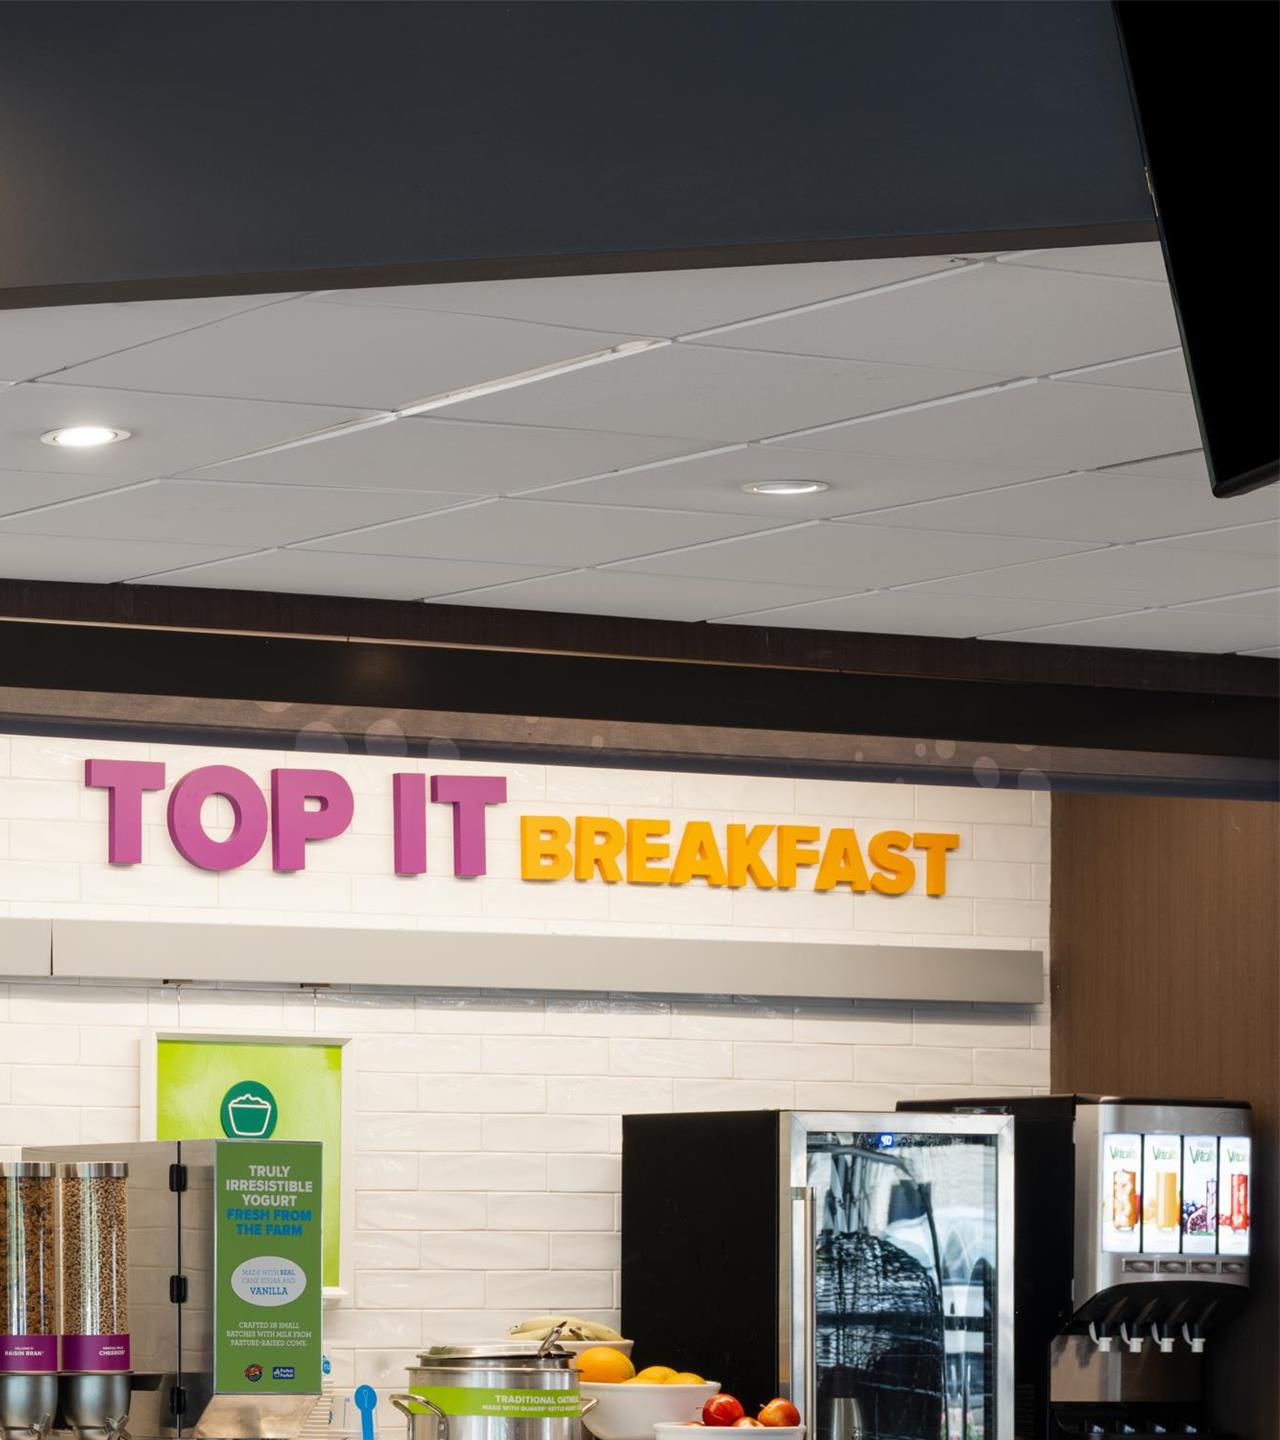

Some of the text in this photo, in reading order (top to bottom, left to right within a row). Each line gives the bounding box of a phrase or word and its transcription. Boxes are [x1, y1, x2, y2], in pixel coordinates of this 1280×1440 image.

[84, 758, 961, 897] TOP IT BREAKFAST
[248, 1164, 290, 1178] TRULY
[225, 1179, 313, 1193] IRRESISTIBLE
[242, 1194, 297, 1207] YOGURT
[225, 1208, 313, 1222] FRESH FROM
[236, 1223, 304, 1236] THE FARM
[249, 1286, 288, 1296] VANILLA
[238, 1321, 300, 1329] CRAFTED IN SMALL
[226, 1330, 256, 1338] BATCHES
[257, 1330, 276, 1338] WITH
[276, 1330, 292, 1338] MILK
[495, 1394, 556, 1404] TRADITIONAL
